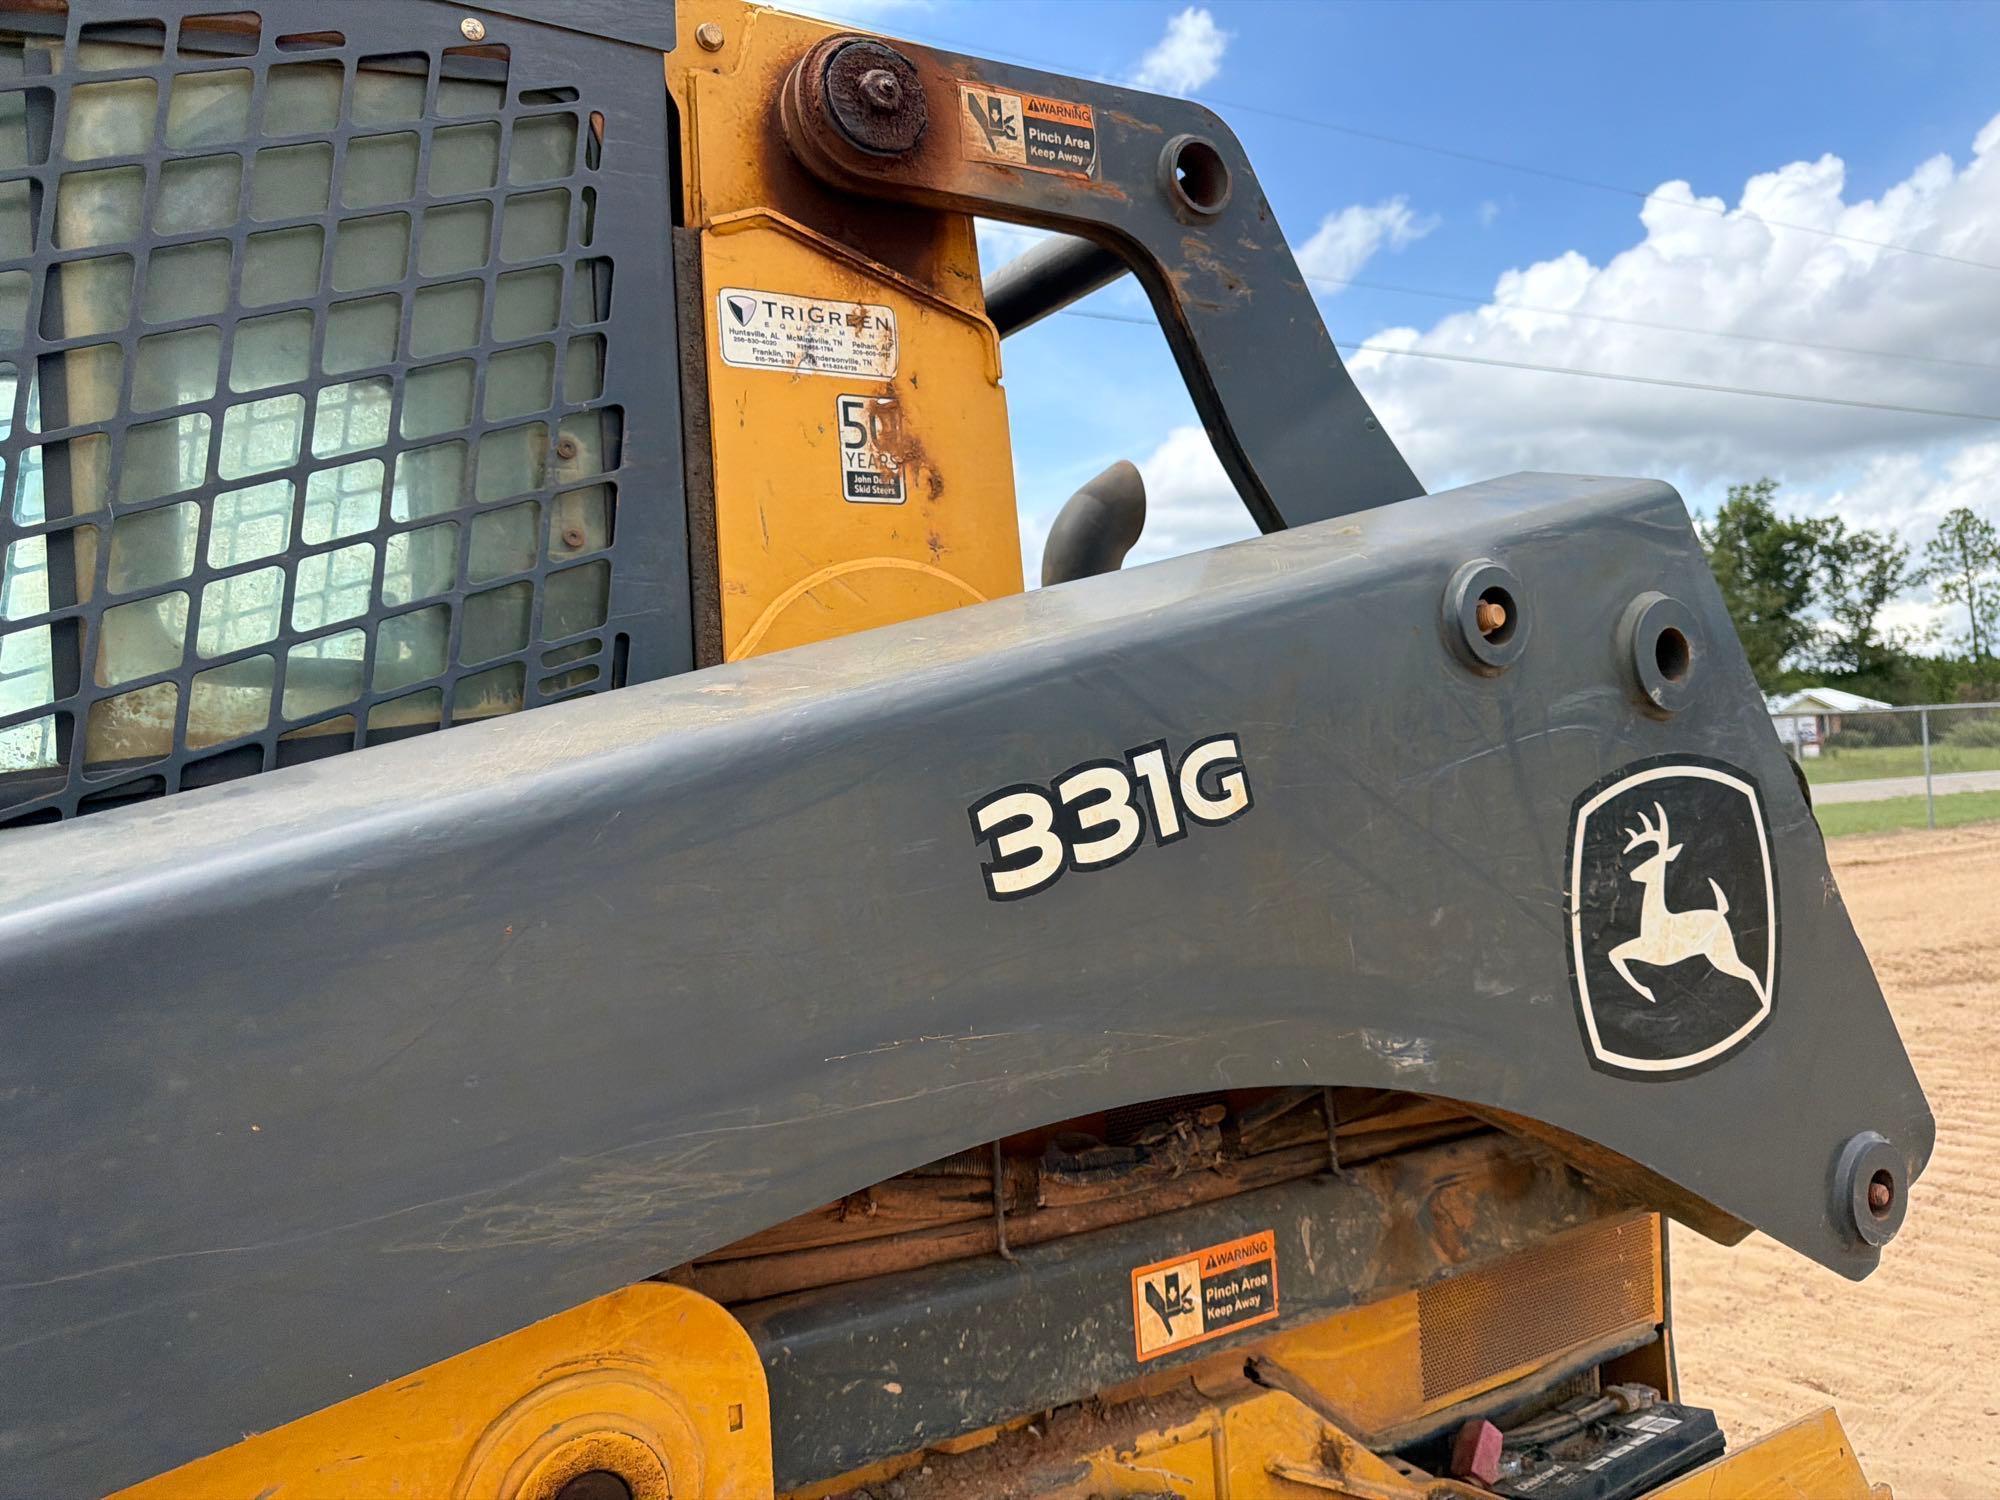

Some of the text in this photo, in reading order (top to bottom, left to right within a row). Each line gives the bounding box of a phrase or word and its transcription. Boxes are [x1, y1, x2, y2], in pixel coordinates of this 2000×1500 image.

[1039, 103, 1090, 121] WARNING
[1029, 127, 1090, 150] Pinch Area
[1030, 146, 1083, 165] Keep Away
[729, 327, 767, 340] Huntsville,
[752, 347, 796, 359] Franklin, TN
[806, 352, 872, 367] ndersonville, TN
[845, 452, 898, 470] YEARS
[854, 474, 895, 485] John Dere
[854, 485, 896, 495] Skid Steers
[977, 739, 1248, 893] 331G
[1216, 1241, 1268, 1266] WARNING
[1206, 1273, 1267, 1302] Pinch Area
[1207, 1294, 1260, 1320] Keep Away
